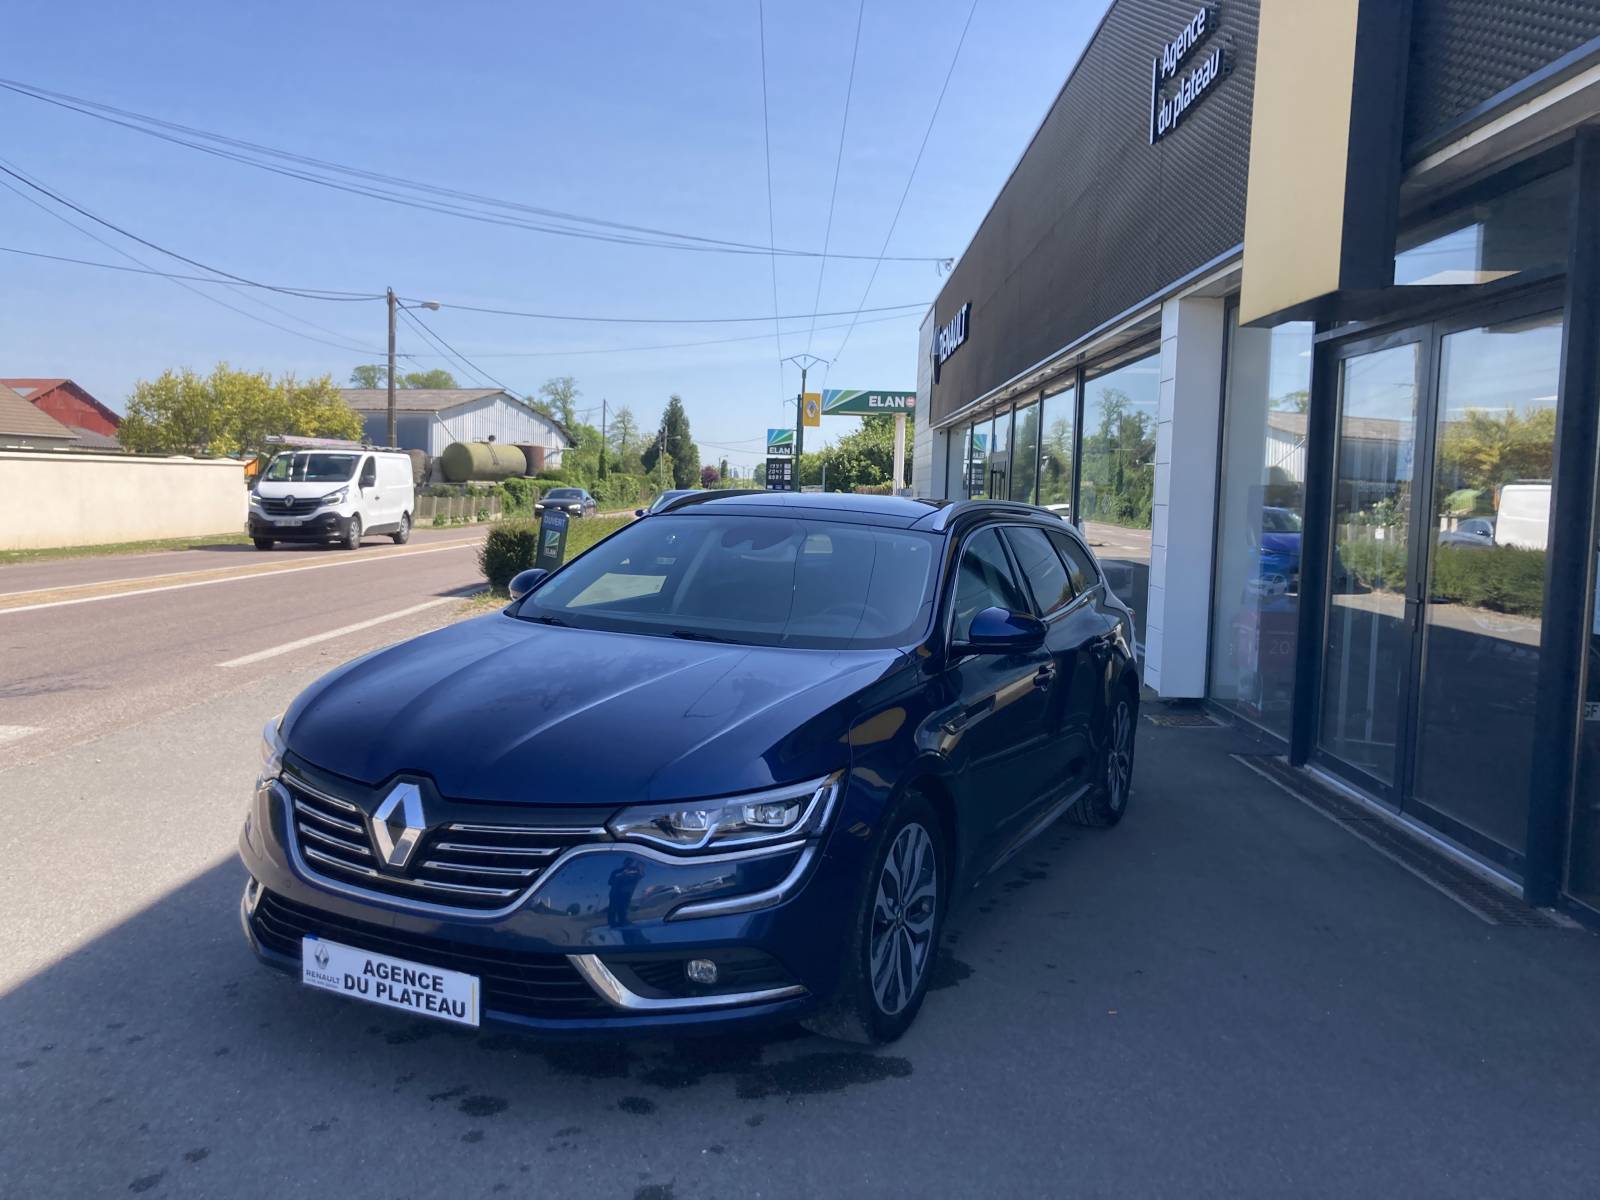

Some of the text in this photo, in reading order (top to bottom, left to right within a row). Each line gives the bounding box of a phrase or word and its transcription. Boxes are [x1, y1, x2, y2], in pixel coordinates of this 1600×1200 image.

[1161, 7, 1206, 79] Agence
[1158, 48, 1220, 135] du plateau
[868, 395, 905, 408] ELAN
[769, 447, 791, 455] ELAN
[305, 969, 340, 985] RENAULT
[362, 959, 444, 993] AGENCE
[344, 973, 466, 1018] DU PLATEAU
